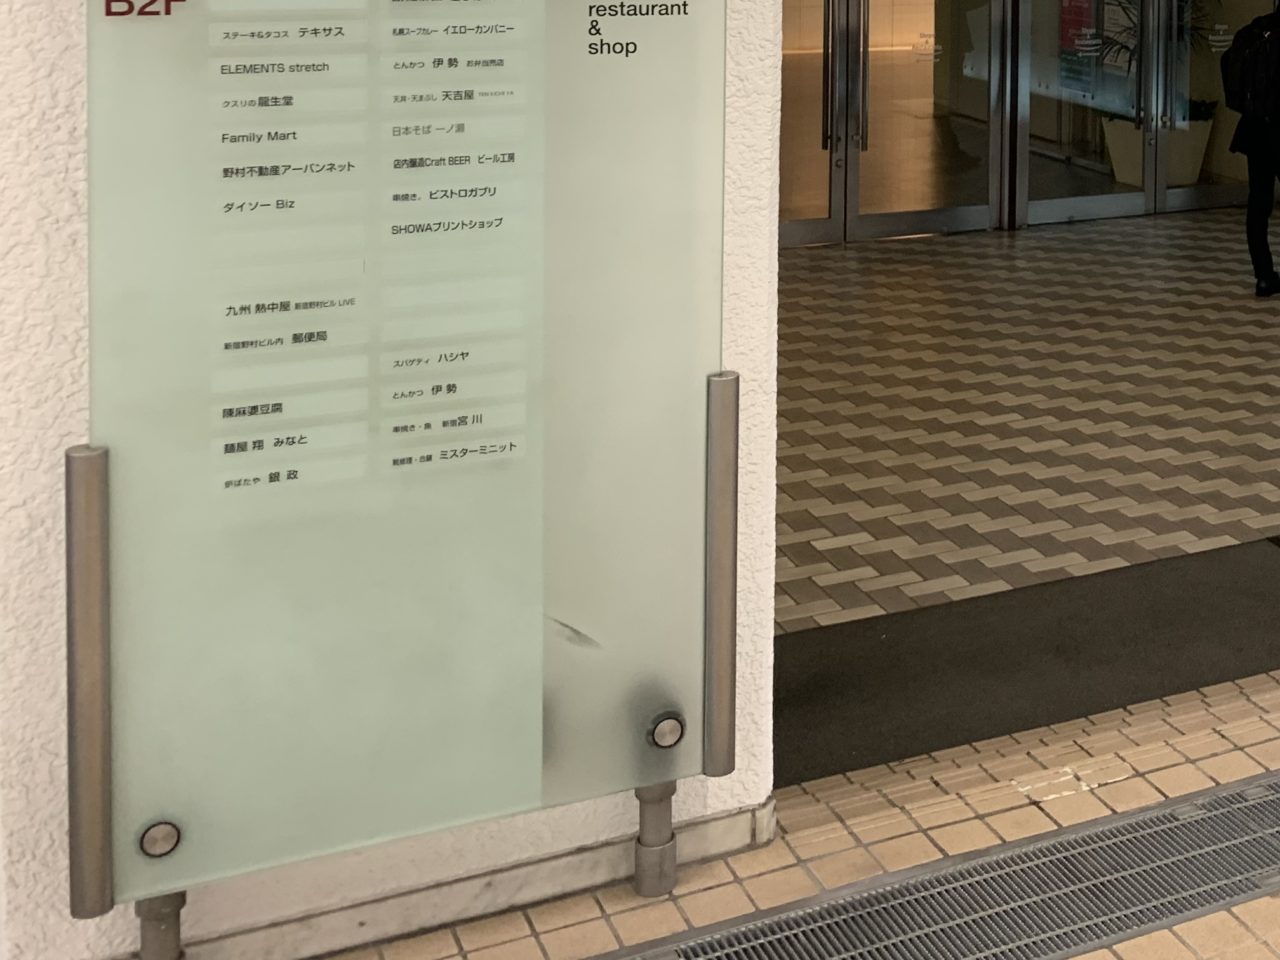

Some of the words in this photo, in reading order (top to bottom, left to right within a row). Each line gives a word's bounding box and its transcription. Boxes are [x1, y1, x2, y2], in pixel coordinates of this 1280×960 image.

[588, 0, 688, 16] restaurant
[298, 27, 345, 38] テキサス
[443, 25, 515, 35] イエローカンパニー
[588, 20, 602, 36] &
[588, 39, 637, 58] shop
[221, 63, 285, 74] ELEMENTS
[289, 62, 330, 73] stretch
[393, 60, 425, 69] とんかつ
[442, 90, 474, 101] 天吉屋
[222, 132, 263, 143] Family
[267, 131, 297, 142] Mart
[392, 124, 432, 136] 日本そば
[448, 155, 470, 166] BEER
[477, 152, 515, 164] ビール工房
[222, 162, 355, 178] 野村不動産アーバンネット
[429, 186, 496, 200] ビストロガブリ
[223, 201, 271, 213] ダイソー
[276, 199, 295, 209] Biz
[391, 217, 503, 235] SHOWAプリントショップ
[225, 304, 251, 316] 九州
[255, 300, 291, 314] 熱中屋
[338, 298, 356, 307] LIVE
[292, 330, 327, 344] 郵便局
[438, 351, 469, 363] ハシヤ
[392, 390, 424, 400] とんかつ
[274, 435, 308, 447] みなと
[440, 442, 517, 460] ミスターミニット
